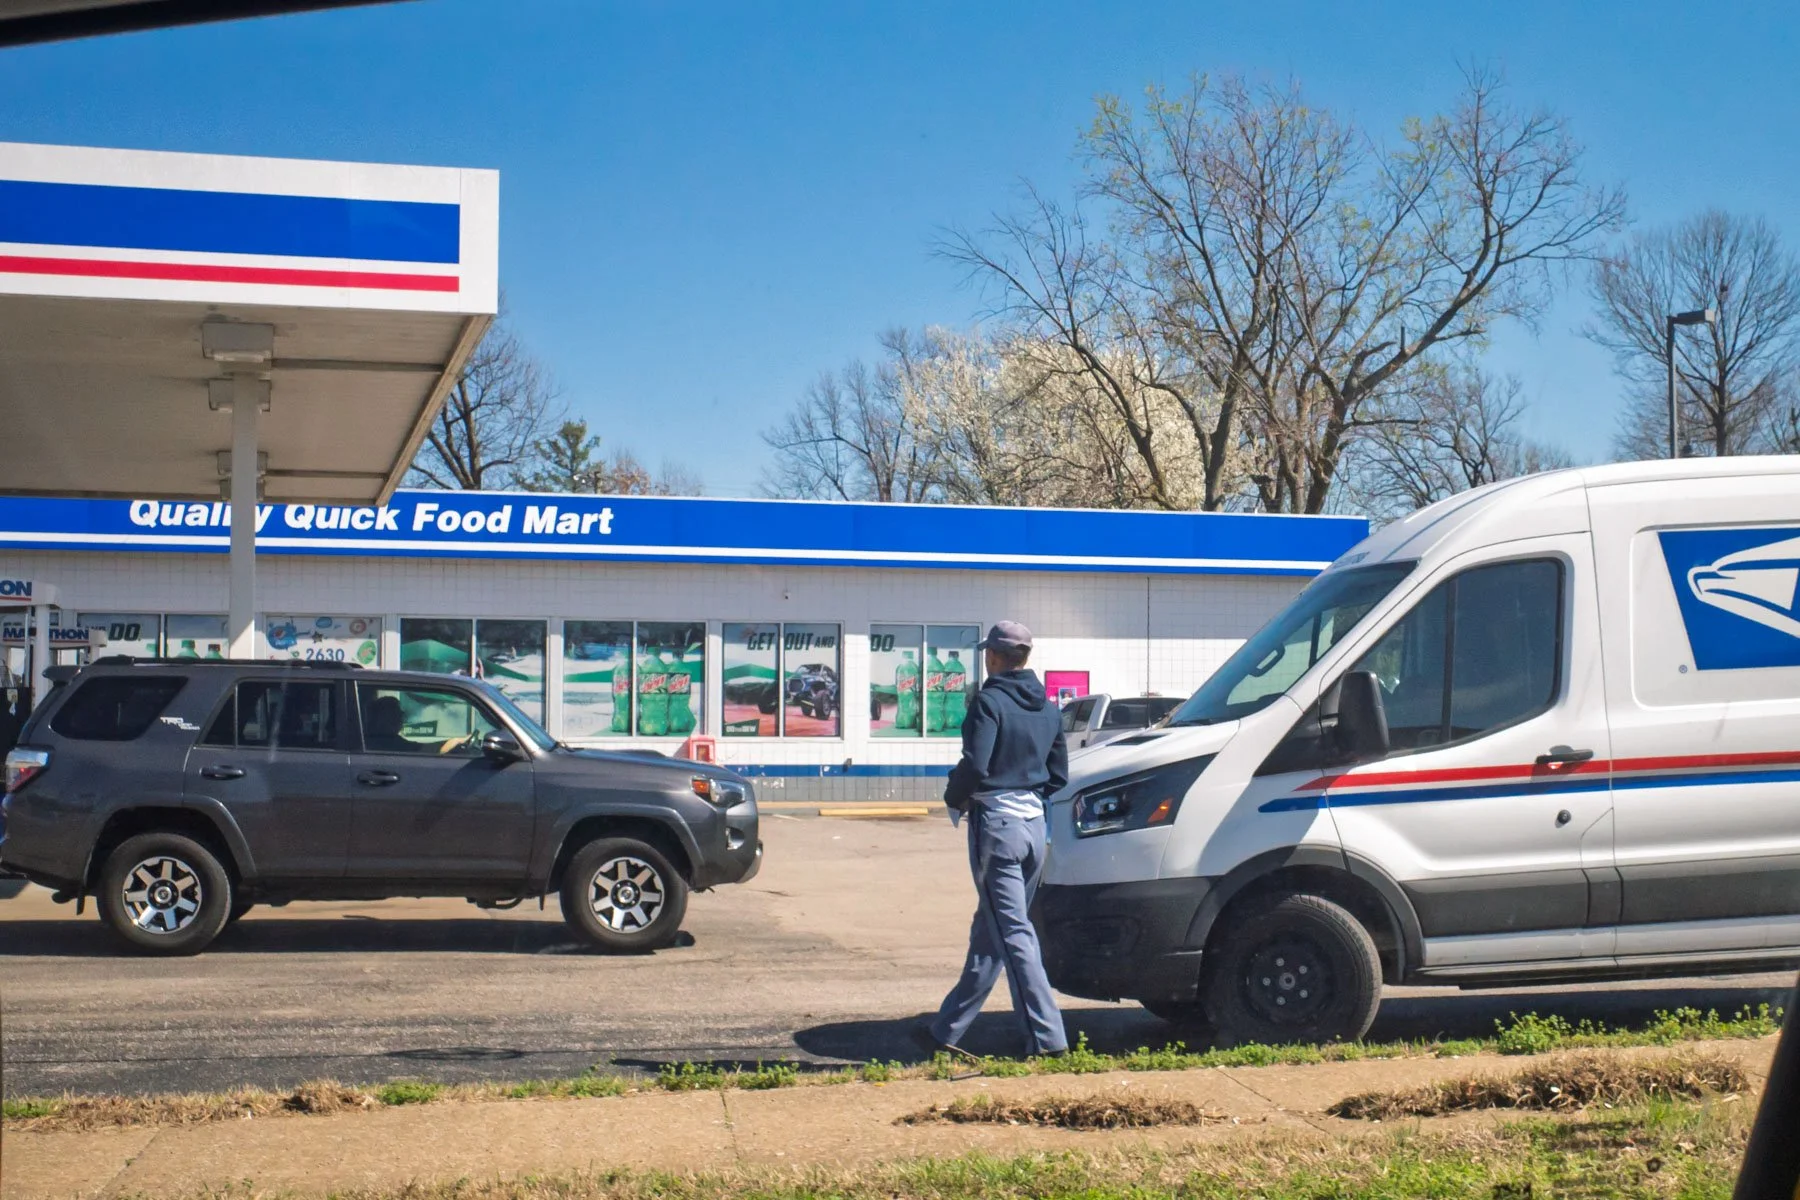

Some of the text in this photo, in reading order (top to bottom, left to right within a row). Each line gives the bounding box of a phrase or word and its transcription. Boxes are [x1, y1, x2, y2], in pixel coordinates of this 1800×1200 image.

[284, 504, 401, 532] Quick
[412, 503, 512, 533] Food
[522, 506, 614, 534] Mart
[747, 632, 775, 651] GET
[784, 632, 813, 651] OUT
[815, 636, 835, 648] AND
[306, 648, 345, 661] 2630
